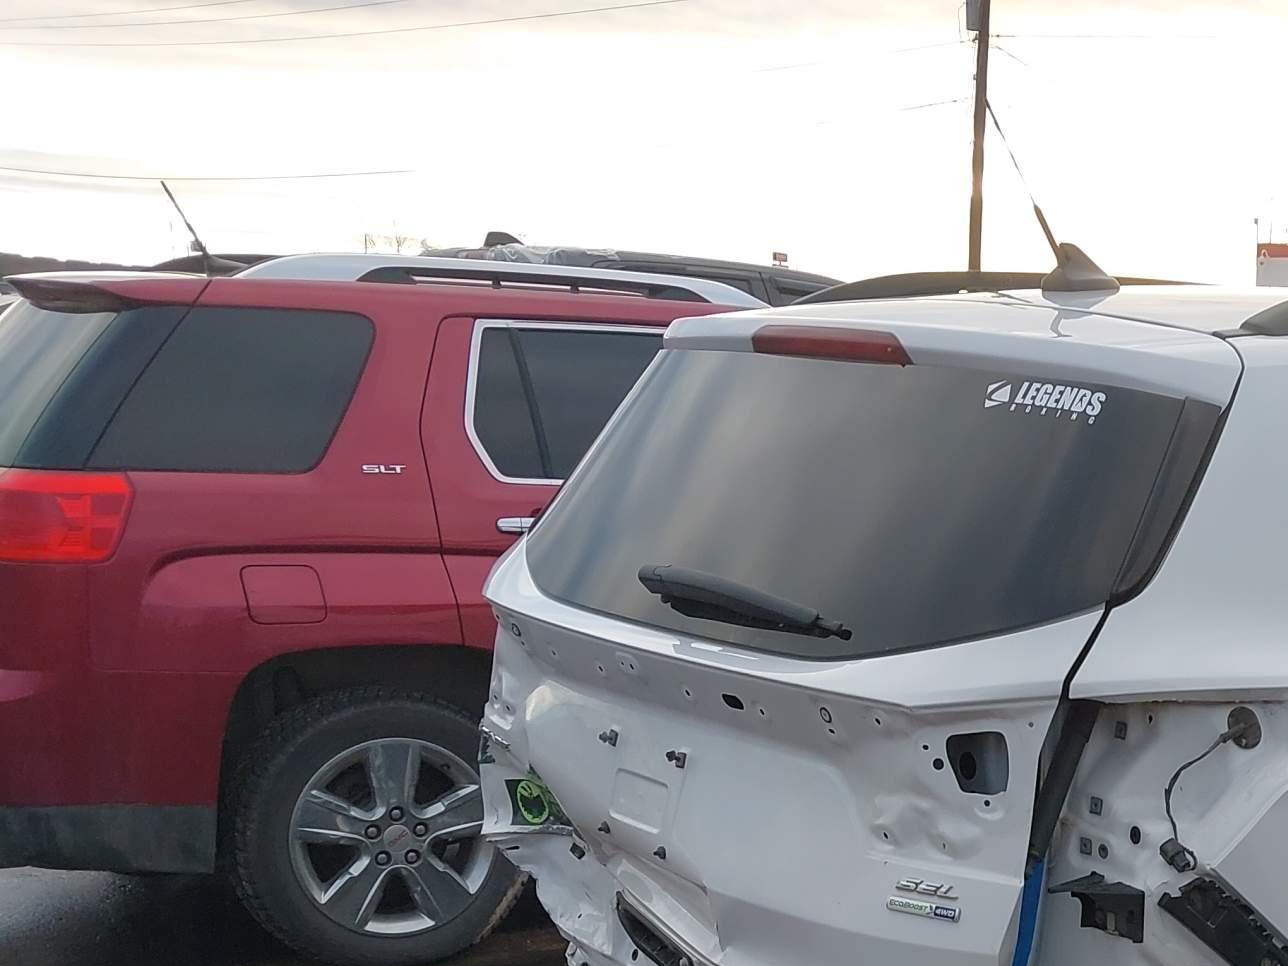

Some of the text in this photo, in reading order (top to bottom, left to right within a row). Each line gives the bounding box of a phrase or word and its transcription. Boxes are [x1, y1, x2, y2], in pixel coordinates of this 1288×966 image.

[1014, 381, 1107, 416] LEGENDS
[362, 464, 407, 474] SLT
[896, 878, 959, 900] SEL
